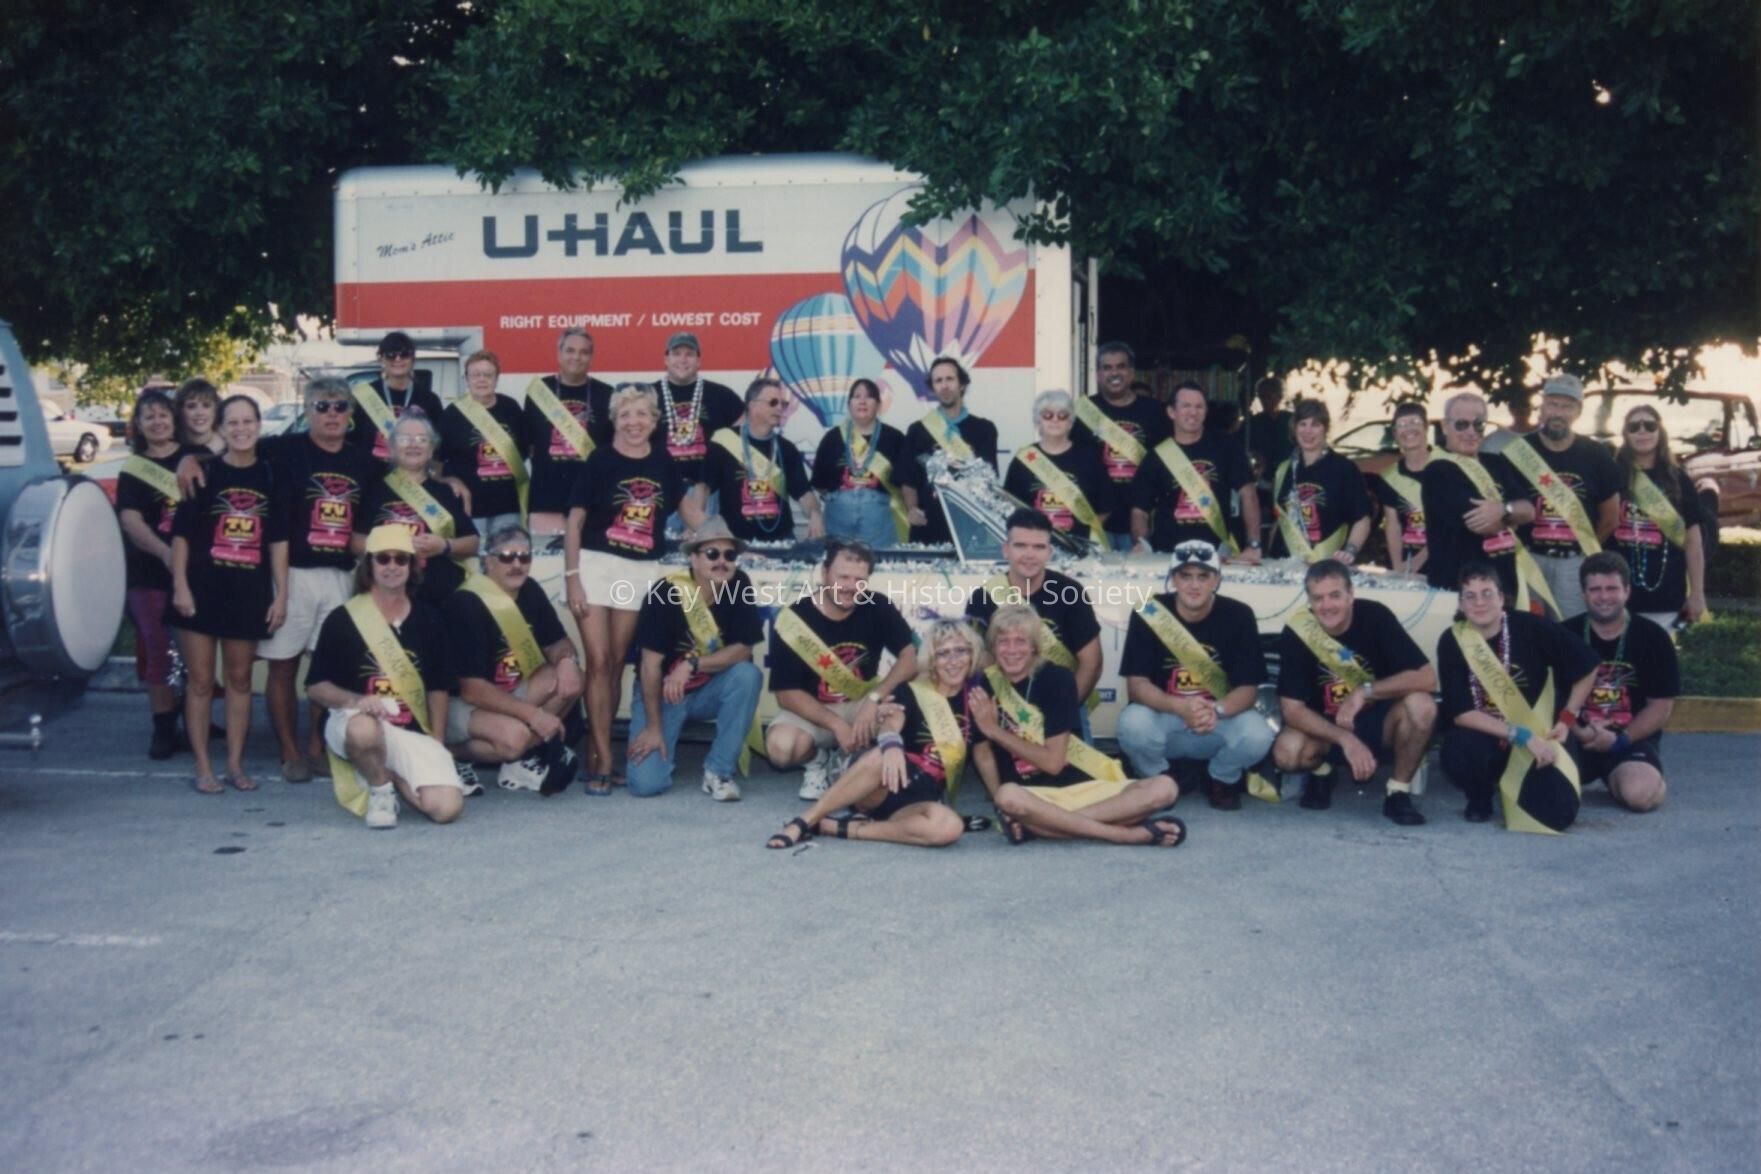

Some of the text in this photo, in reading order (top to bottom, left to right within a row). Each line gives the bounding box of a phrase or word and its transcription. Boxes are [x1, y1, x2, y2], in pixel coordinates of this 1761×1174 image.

[482, 209, 764, 259] U-HAUL
[376, 231, 455, 258] Mom's Attic
[500, 311, 762, 328] RIGHT EQUIPMENT / LOWEST COST
[321, 502, 347, 517] TV
[626, 506, 652, 519] TV
[225, 518, 254, 533] TV
[1474, 643, 1517, 706] MONITOR
